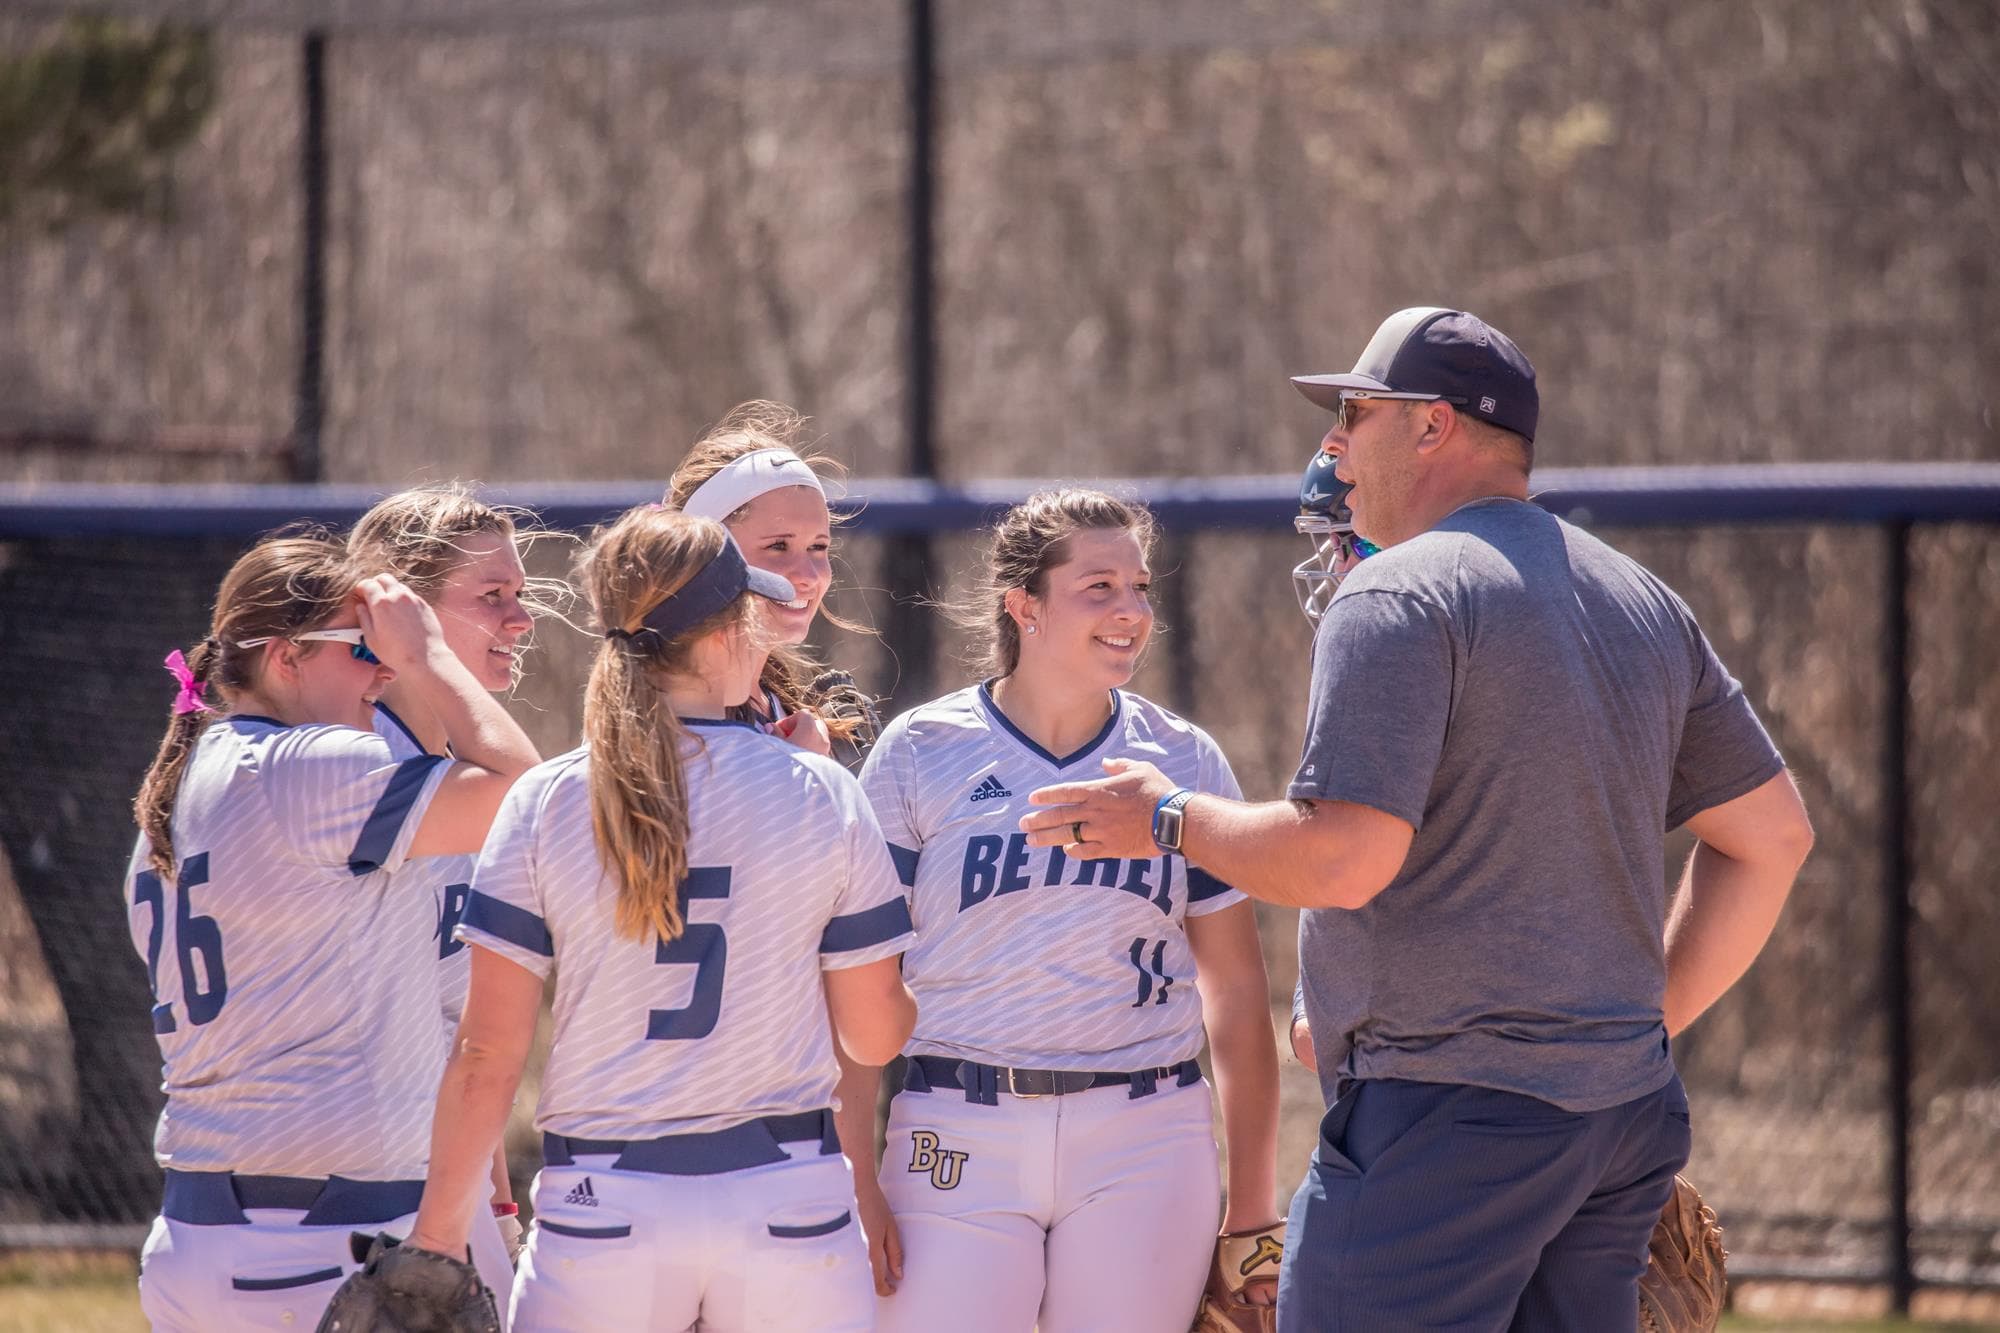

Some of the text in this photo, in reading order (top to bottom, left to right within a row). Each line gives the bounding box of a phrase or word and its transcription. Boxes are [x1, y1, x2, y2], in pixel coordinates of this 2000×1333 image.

[970, 789, 1012, 802] adidas
[646, 866, 732, 1040] 5
[1128, 937, 1174, 1008] 11
[908, 1131, 969, 1190] BU
